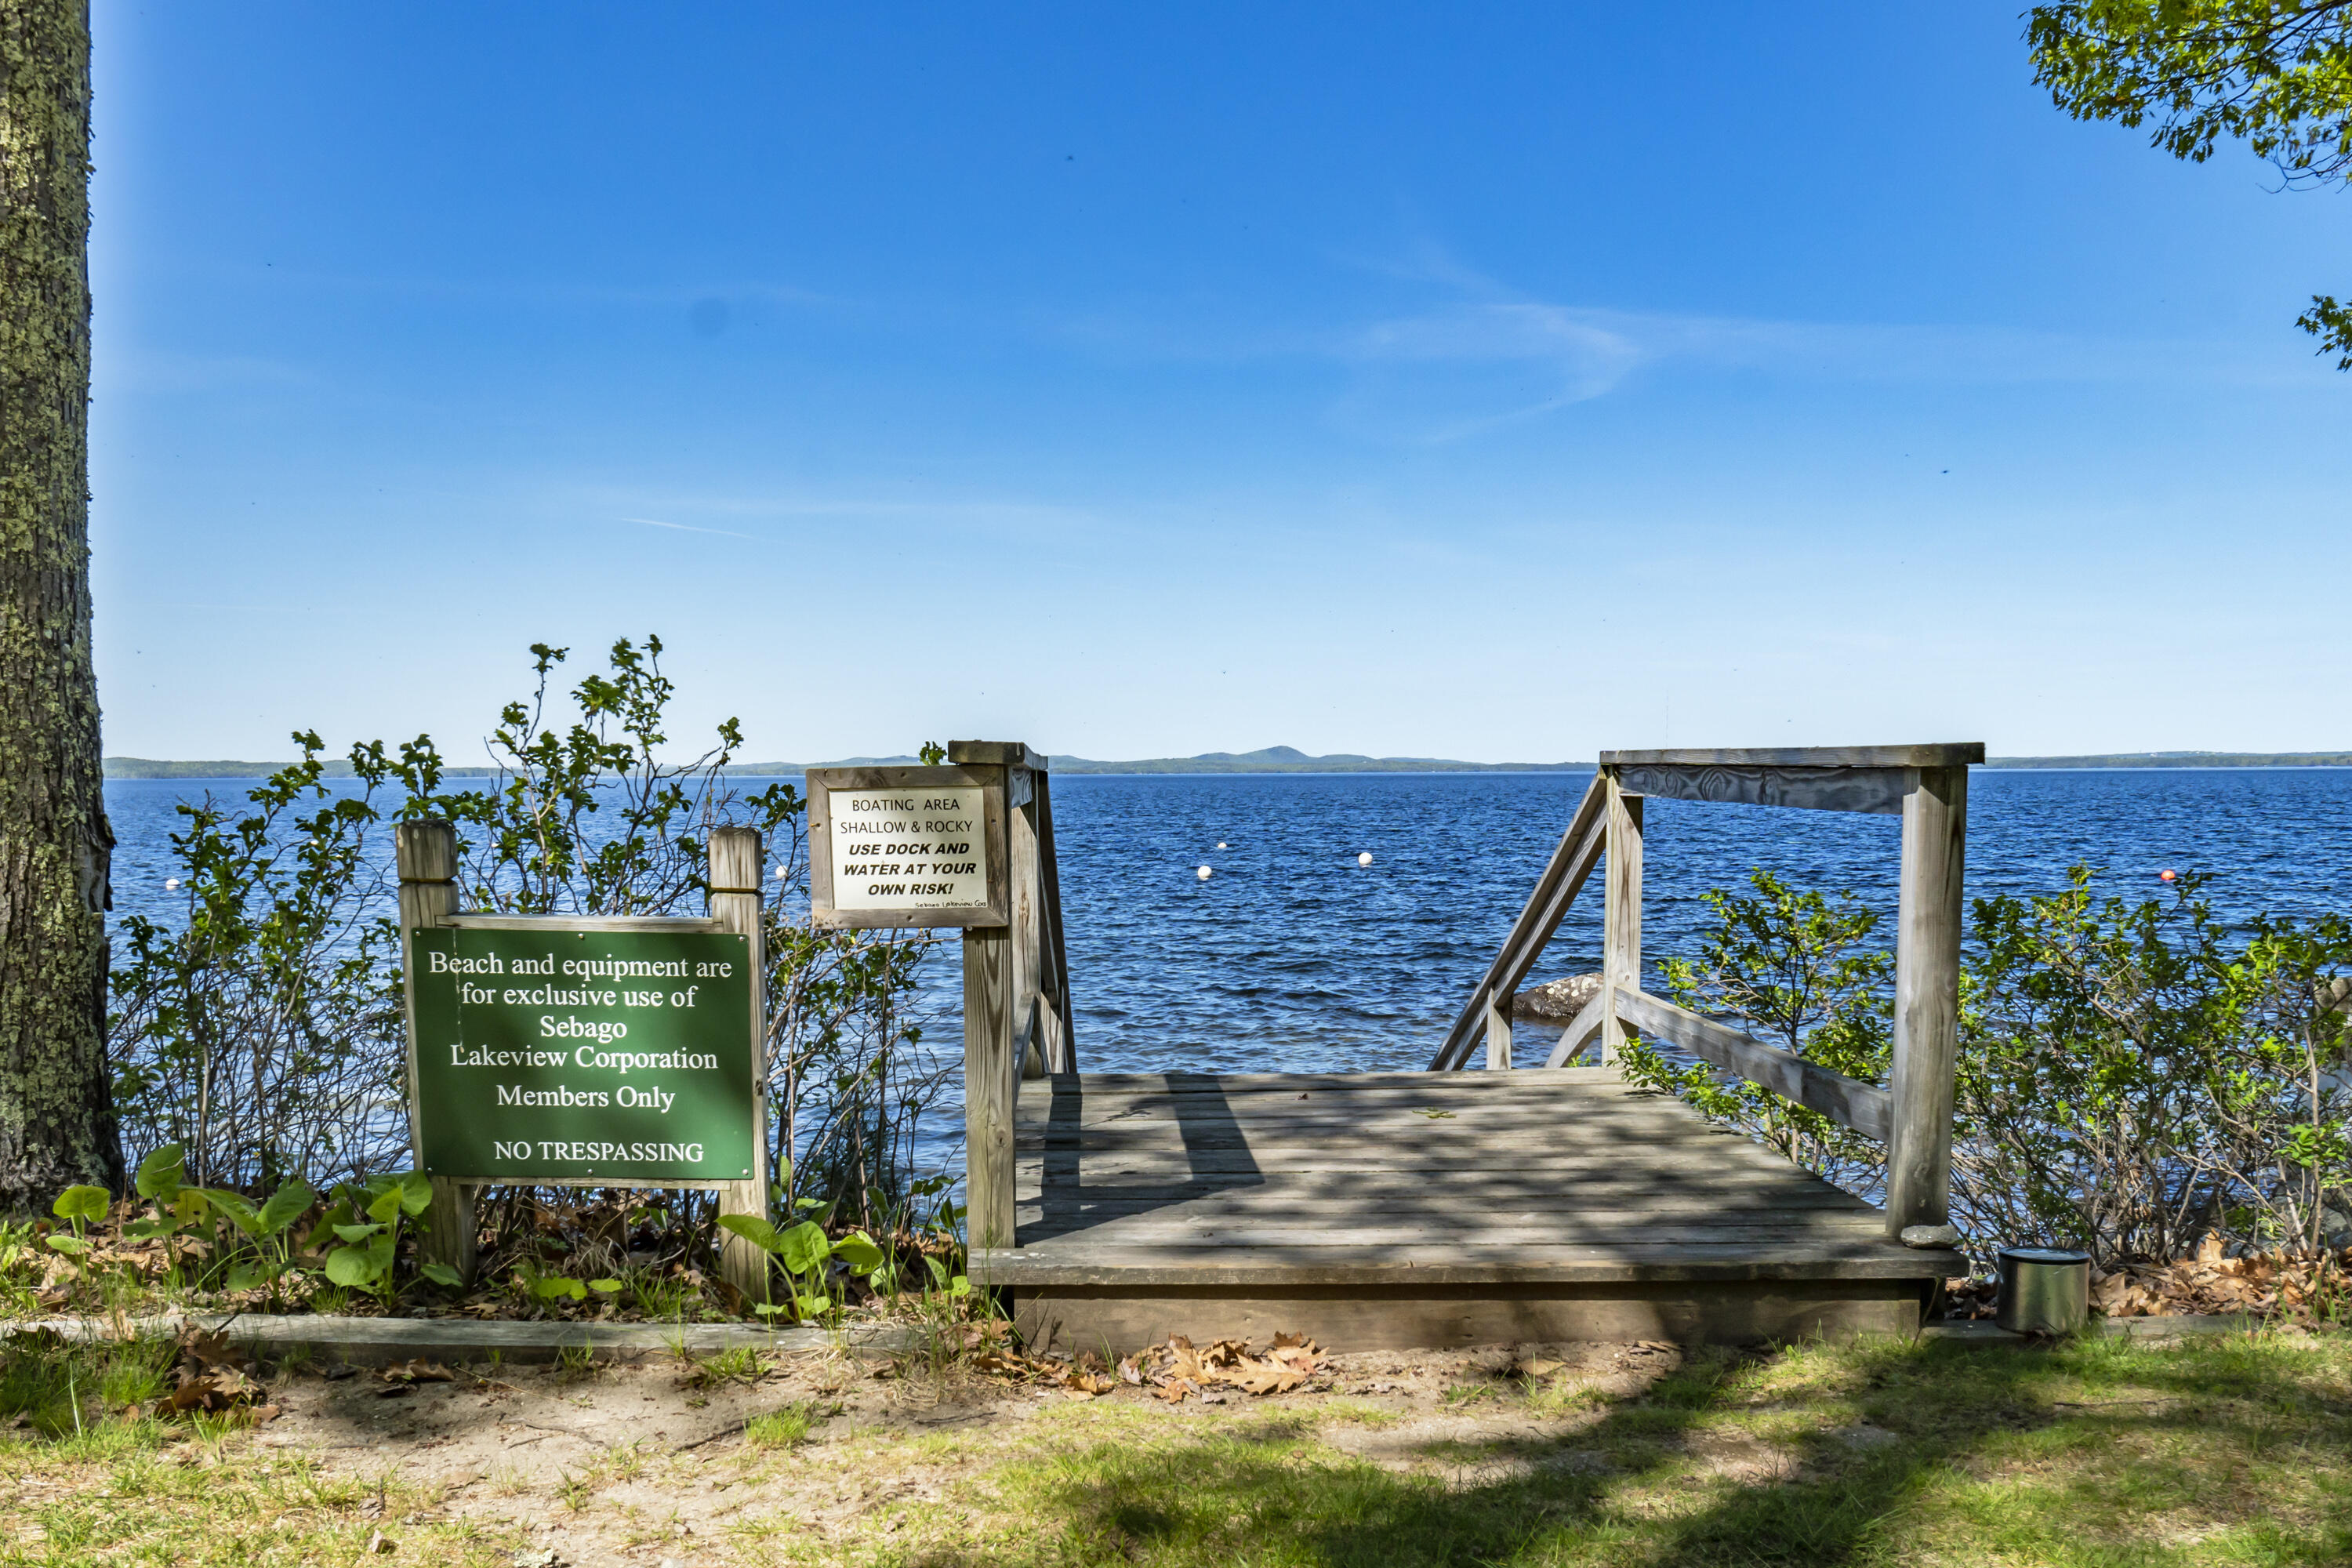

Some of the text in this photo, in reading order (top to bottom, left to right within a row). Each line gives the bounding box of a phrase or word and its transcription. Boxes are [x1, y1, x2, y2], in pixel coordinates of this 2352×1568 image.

[852, 799, 960, 811] BOATING AREA
[840, 821, 973, 833] SHALLOW & ROCKY
[849, 844, 970, 855] USE DOCK AND
[844, 863, 976, 875] WATER AT YOUR
[868, 884, 954, 895] OWN RISK!
[428, 952, 732, 982] Beach and equipment are
[461, 982, 699, 1007] for exclusive use of
[540, 1015, 627, 1044] Sebago
[450, 1044, 718, 1073] Lakeview Corporation
[496, 1085, 676, 1113] Members Only
[494, 1141, 704, 1163] NO TRESPASSING
